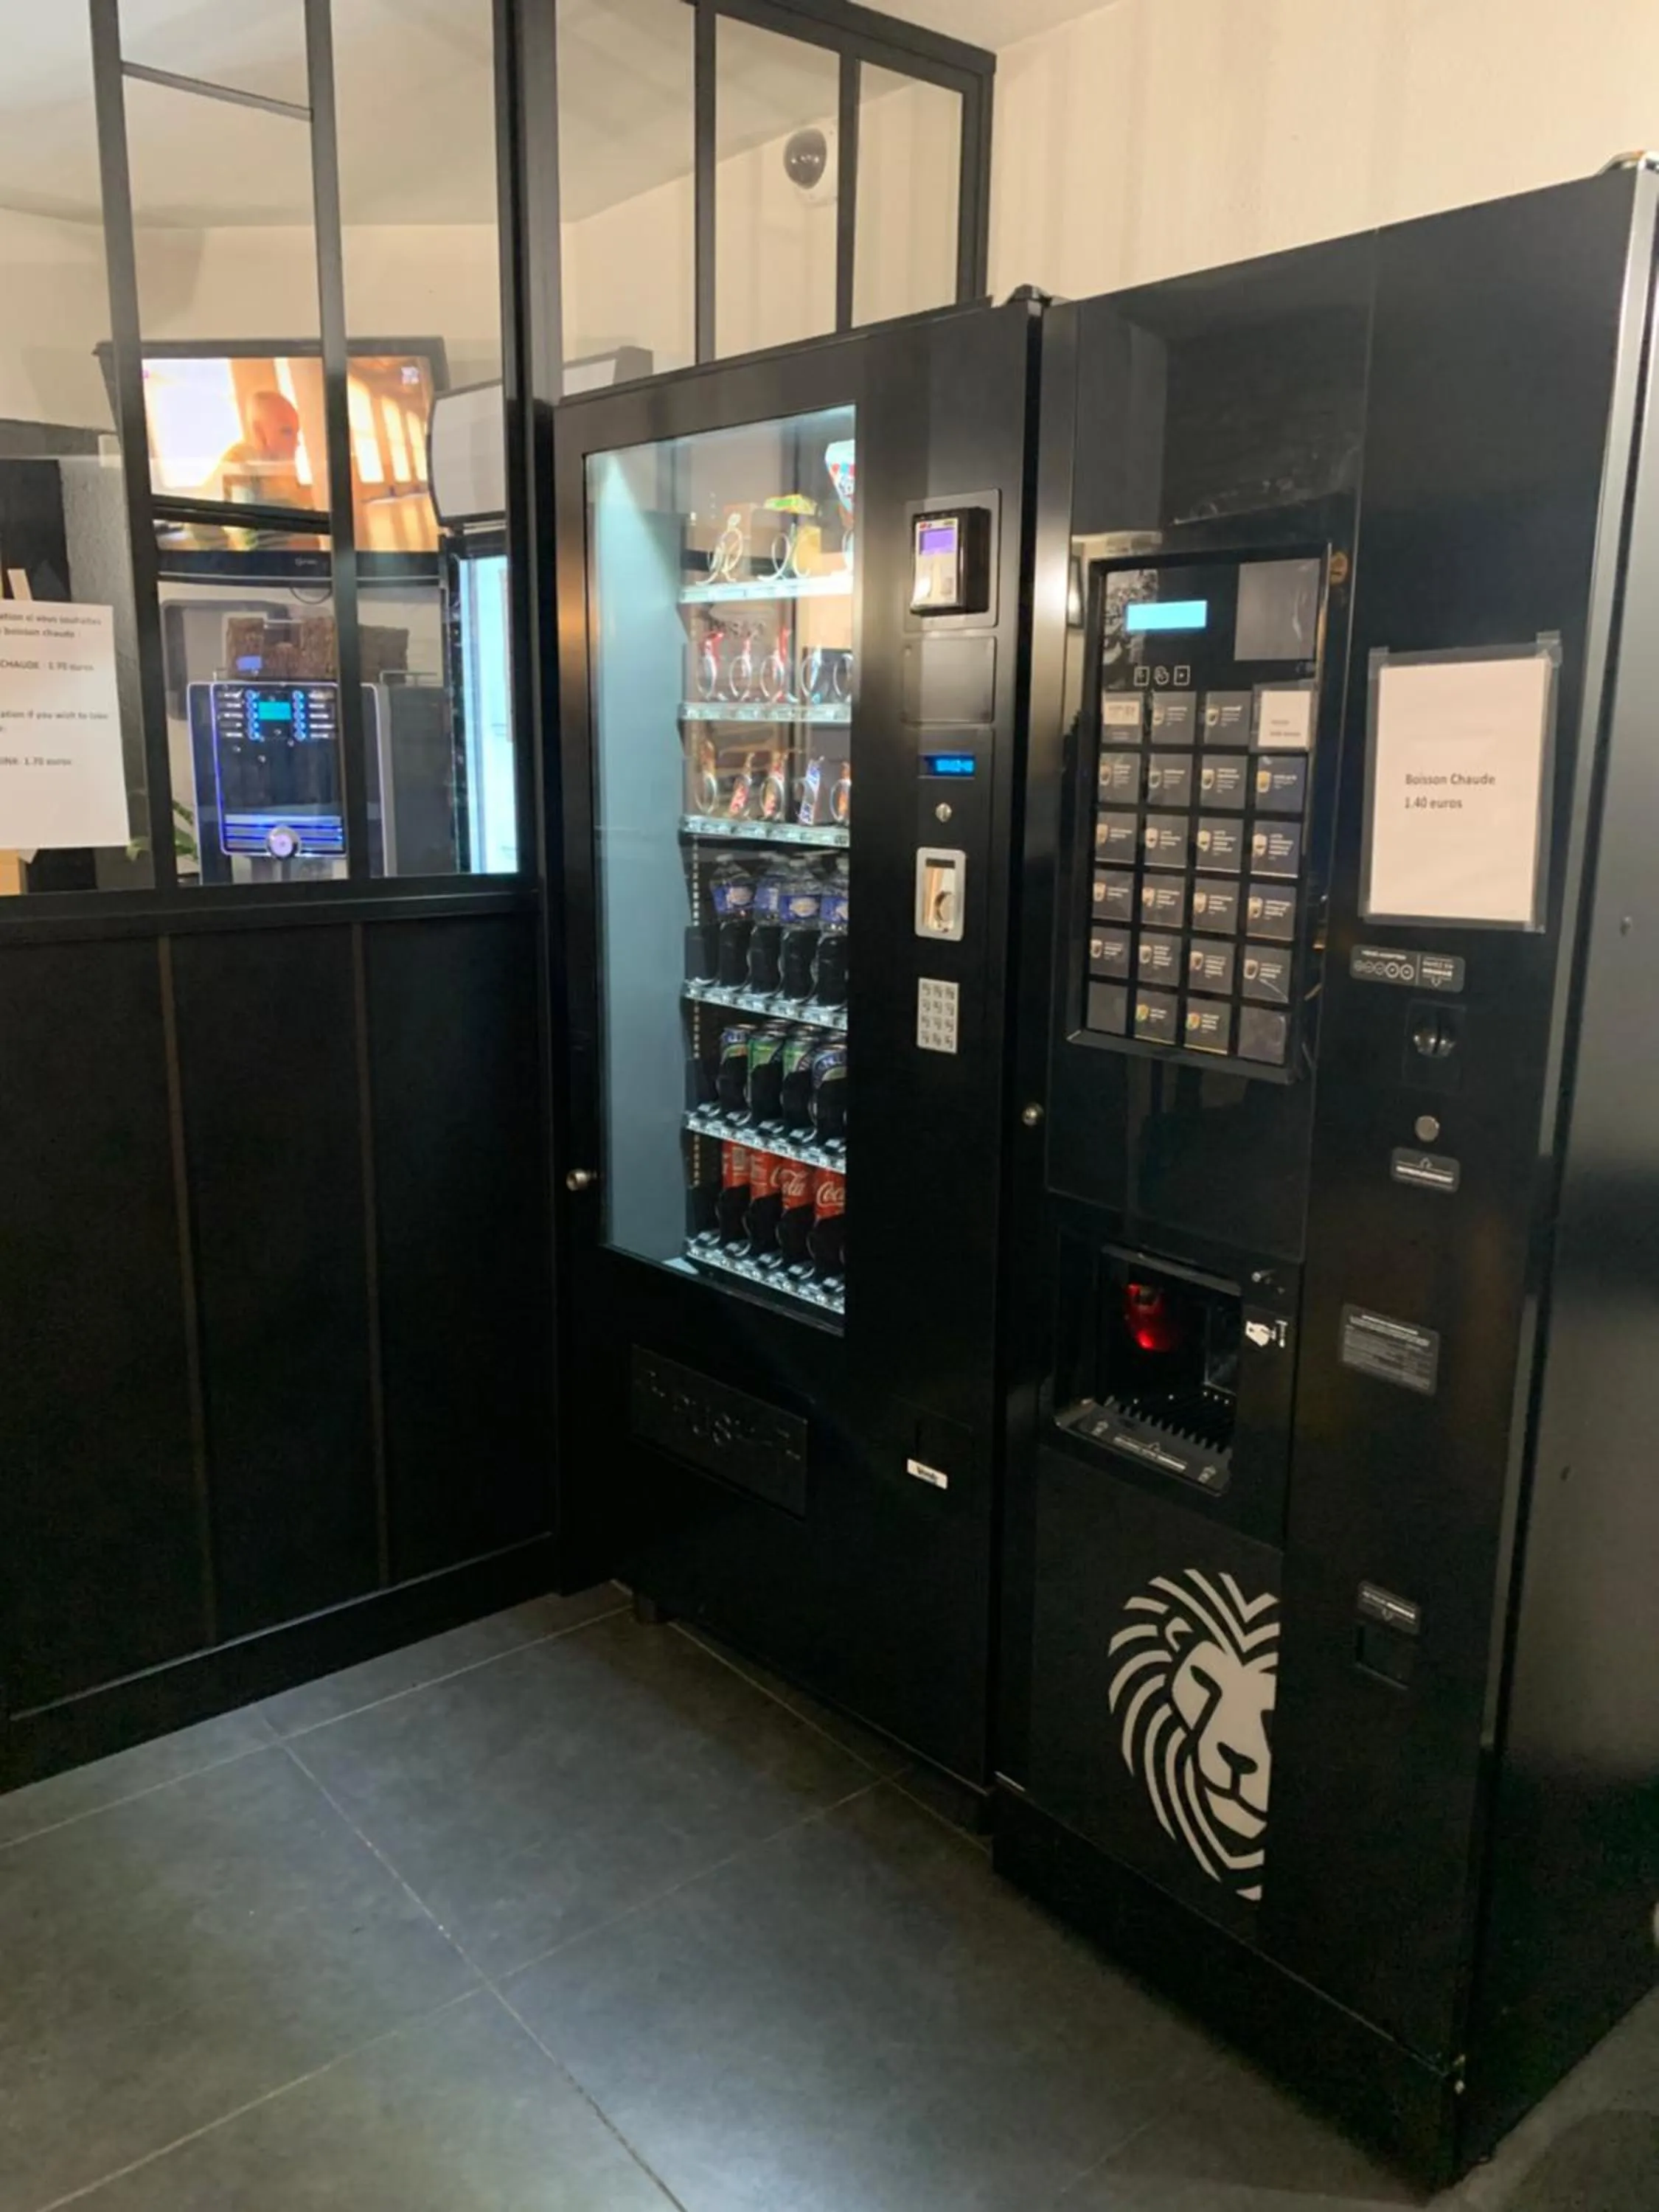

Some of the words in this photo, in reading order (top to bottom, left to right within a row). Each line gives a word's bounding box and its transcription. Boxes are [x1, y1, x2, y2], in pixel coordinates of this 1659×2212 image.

[1405, 774, 1447, 785] Boisson
[1450, 773, 1496, 785] Chaude
[1405, 796, 1427, 809] 1.40
[1430, 799, 1462, 809] euros
